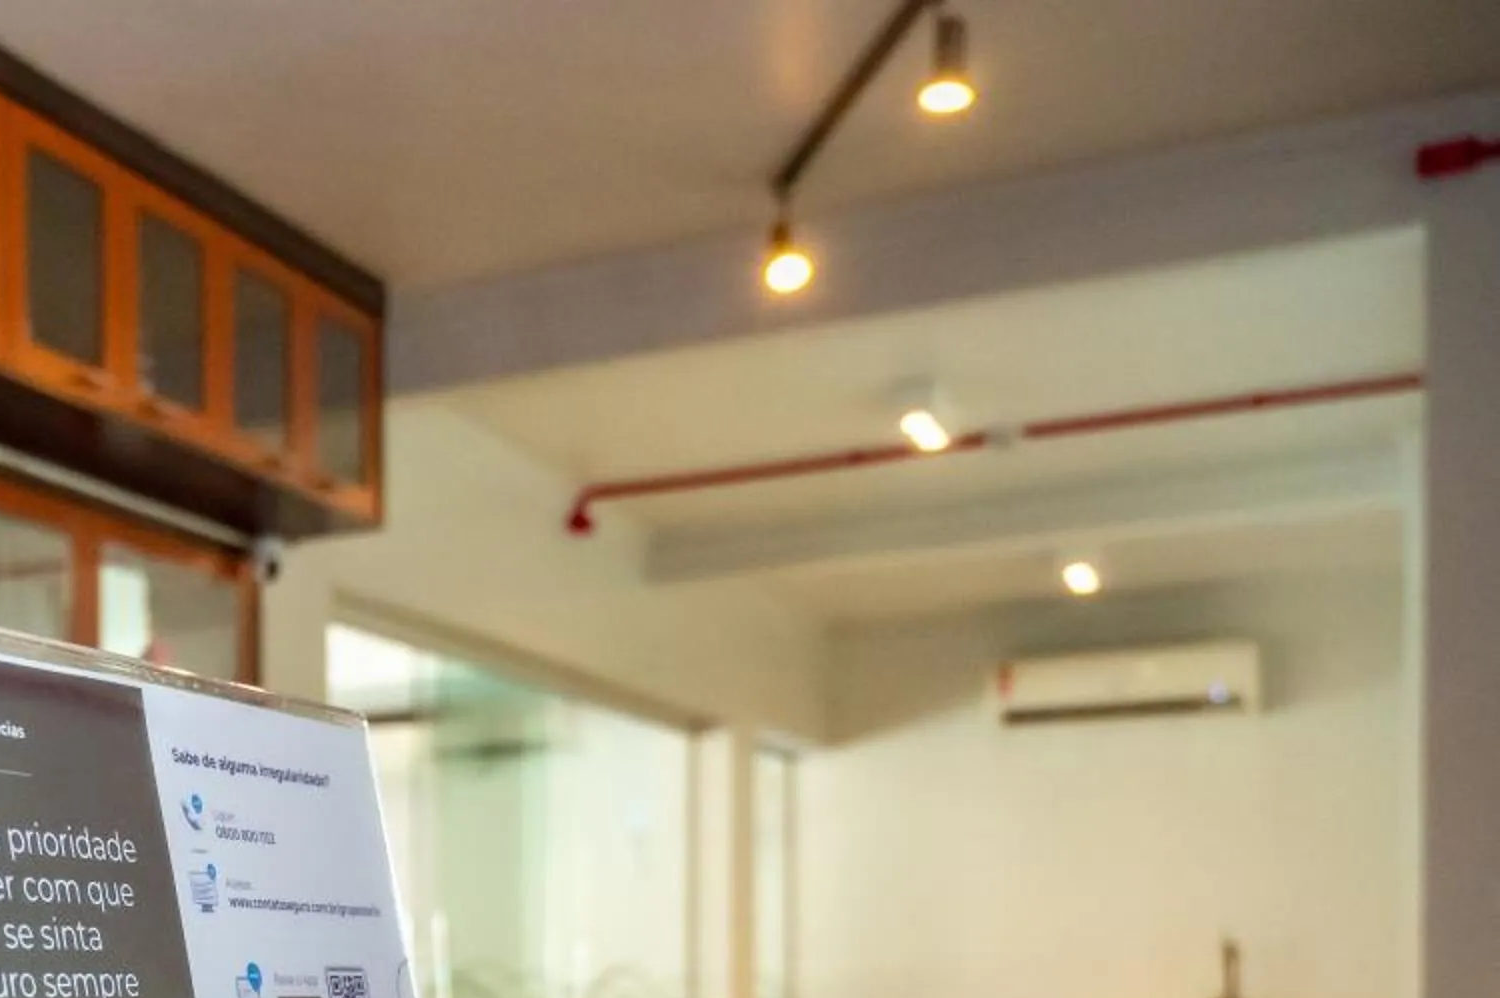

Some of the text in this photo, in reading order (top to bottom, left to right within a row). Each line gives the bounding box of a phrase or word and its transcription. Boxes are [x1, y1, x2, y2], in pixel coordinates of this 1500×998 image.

[171, 747, 200, 767] Sabe
[201, 752, 218, 769] de
[218, 755, 258, 776] alguma
[7, 821, 138, 863] prioridade
[23, 876, 81, 904] com
[87, 880, 135, 912] que
[3, 925, 34, 950] se
[40, 916, 103, 951] sinta
